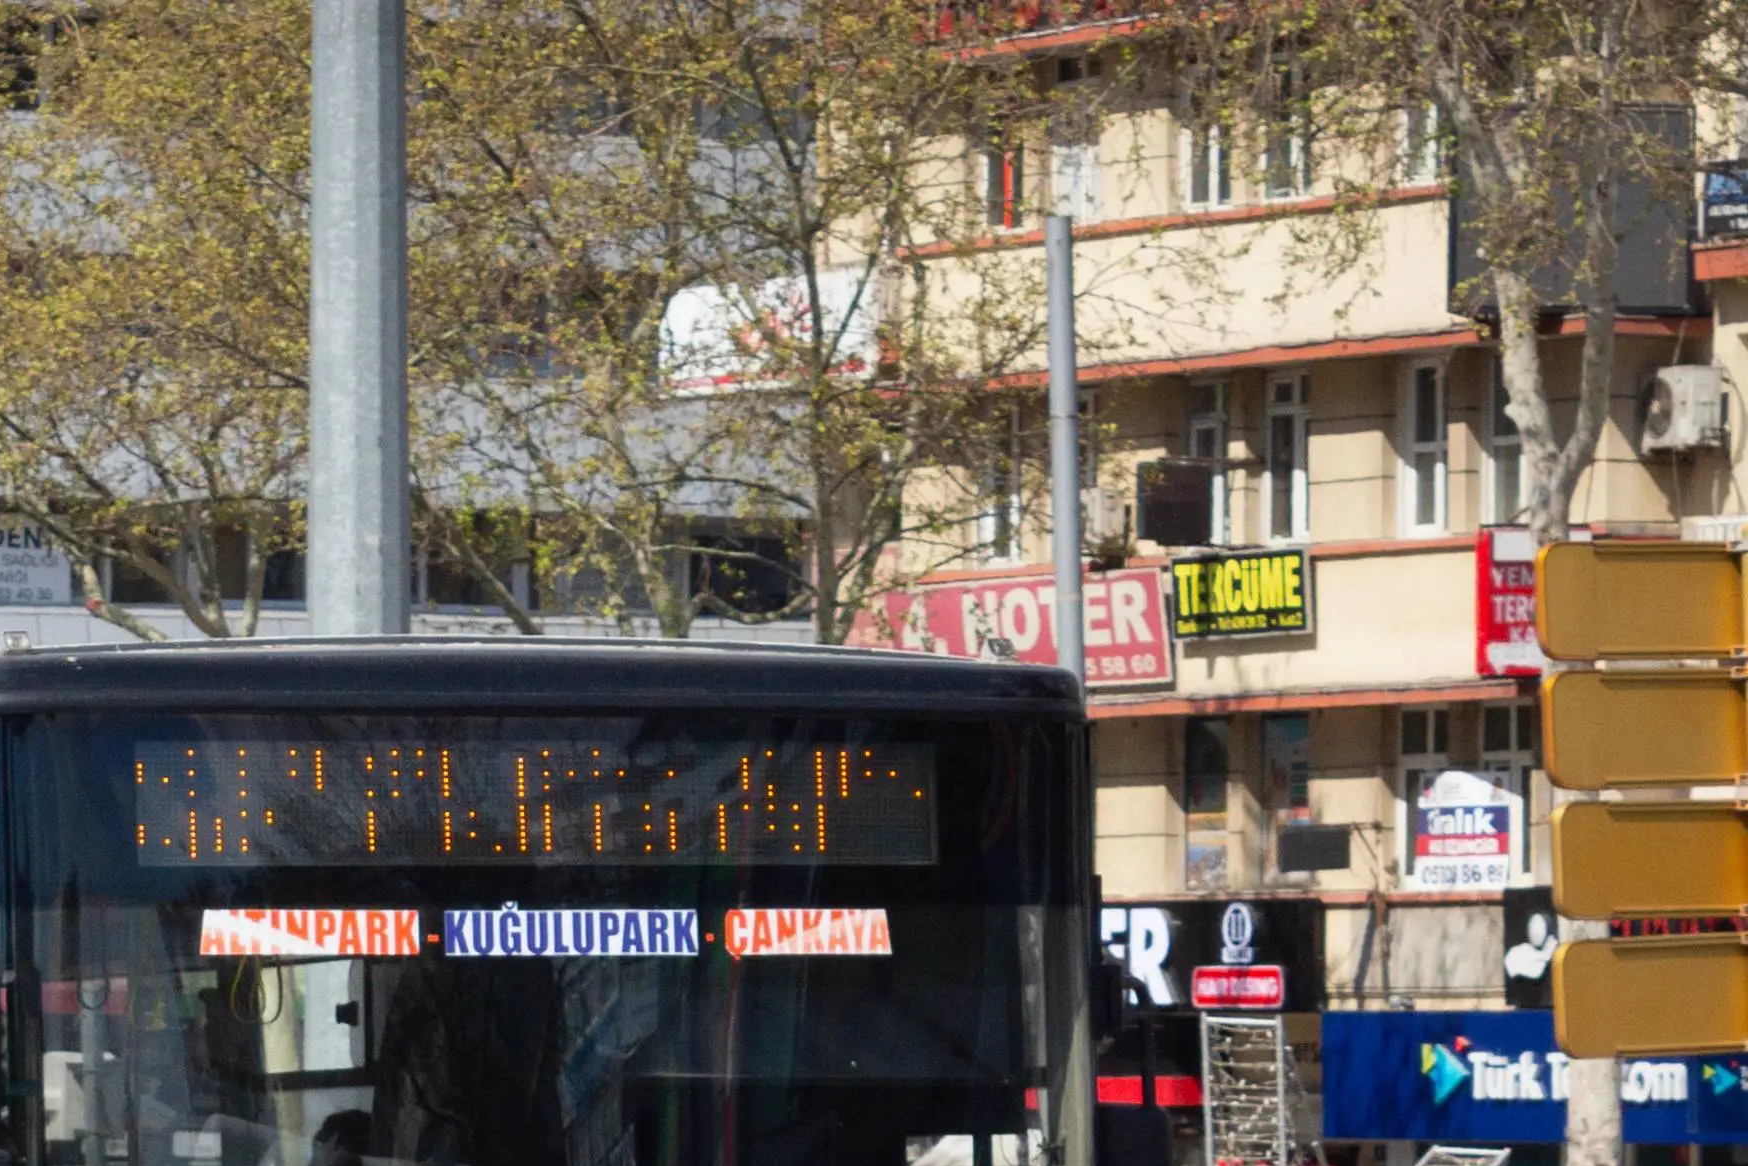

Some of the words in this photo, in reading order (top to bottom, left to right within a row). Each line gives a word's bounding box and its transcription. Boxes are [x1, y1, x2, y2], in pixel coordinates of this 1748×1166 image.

[1174, 555, 1302, 616] TERCÜME
[962, 580, 1155, 656] NOTER
[445, 900, 698, 956] KUĞULUPARK
[725, 909, 890, 961] ÇANKAYA
[1467, 1051, 1546, 1100] Türk
